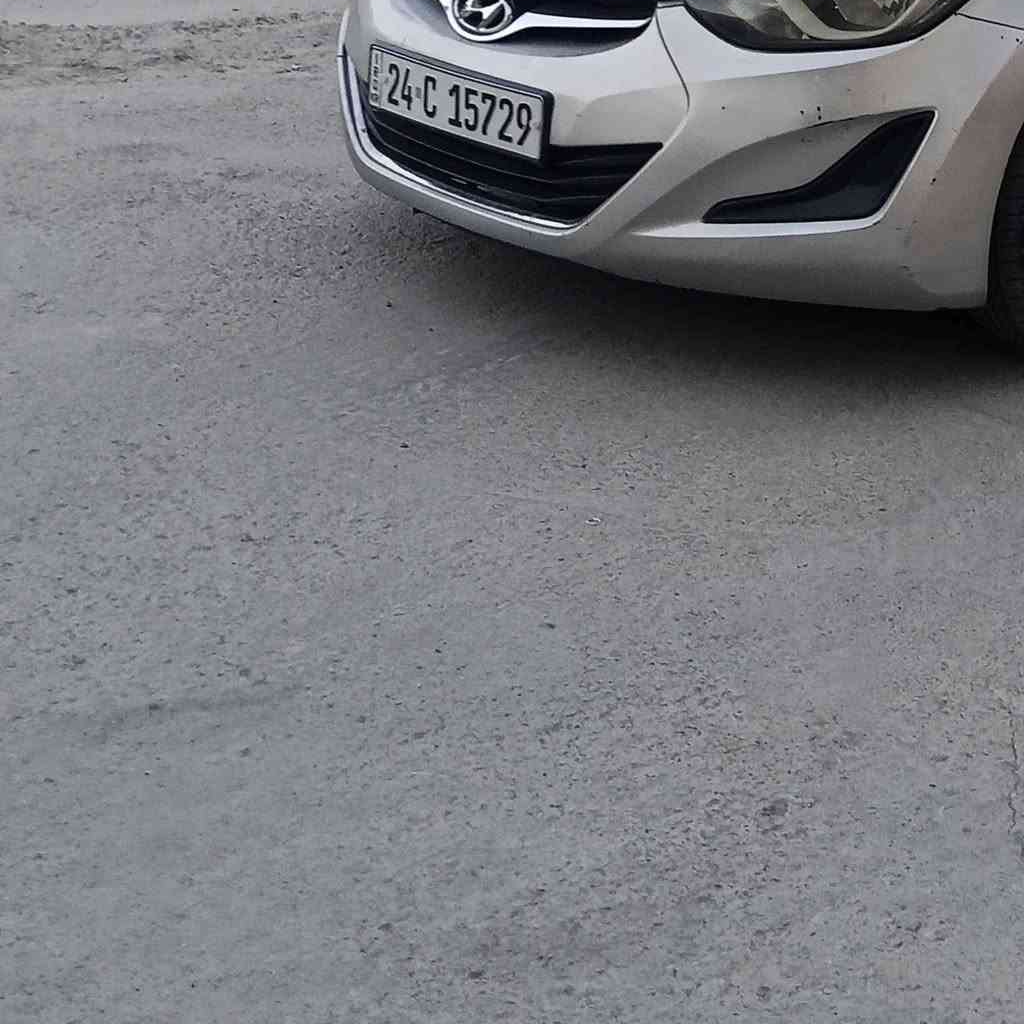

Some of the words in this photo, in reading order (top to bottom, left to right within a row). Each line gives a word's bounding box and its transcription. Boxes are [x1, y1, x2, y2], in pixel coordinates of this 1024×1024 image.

[386, 63, 414, 111] 24
[422, 75, 438, 118] C
[447, 83, 533, 146] 15729
